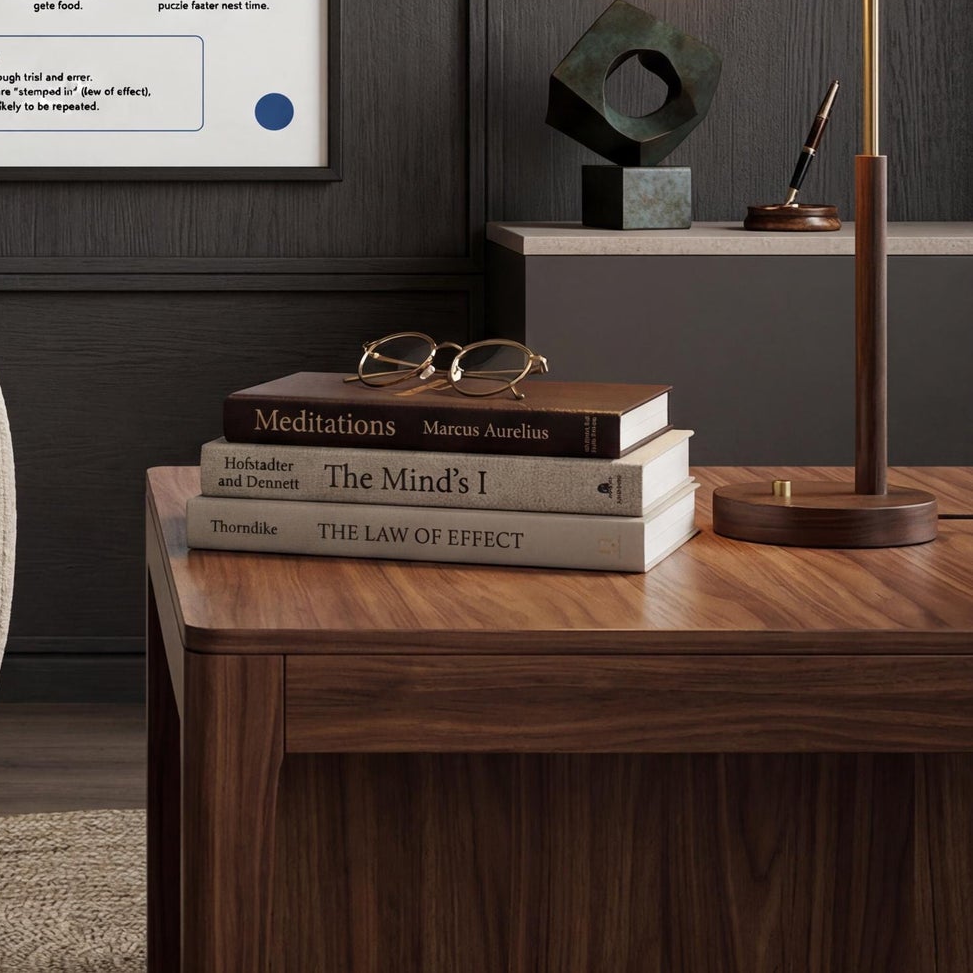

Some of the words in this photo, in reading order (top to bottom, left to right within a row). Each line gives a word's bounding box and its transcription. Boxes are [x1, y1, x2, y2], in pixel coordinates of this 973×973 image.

[57, 0, 83, 10] food.
[244, 0, 270, 10] time.
[45, 72, 64, 82] and
[104, 86, 115, 96] of
[24, 102, 35, 111] to
[37, 101, 50, 111] be
[52, 100, 100, 114] repeated.
[254, 408, 396, 437] Meditations
[423, 420, 480, 437] Marcus
[483, 422, 549, 440] Aurelius
[224, 456, 295, 472] Hofstadter
[217, 473, 243, 488] and
[246, 475, 300, 490] Dennett
[323, 462, 373, 493] The
[477, 470, 487, 495] I
[210, 519, 278, 536] Thorndike
[317, 522, 359, 541] THE
[364, 525, 410, 543] LAW
[414, 527, 442, 545] OF
[447, 529, 524, 549] EFFECT
